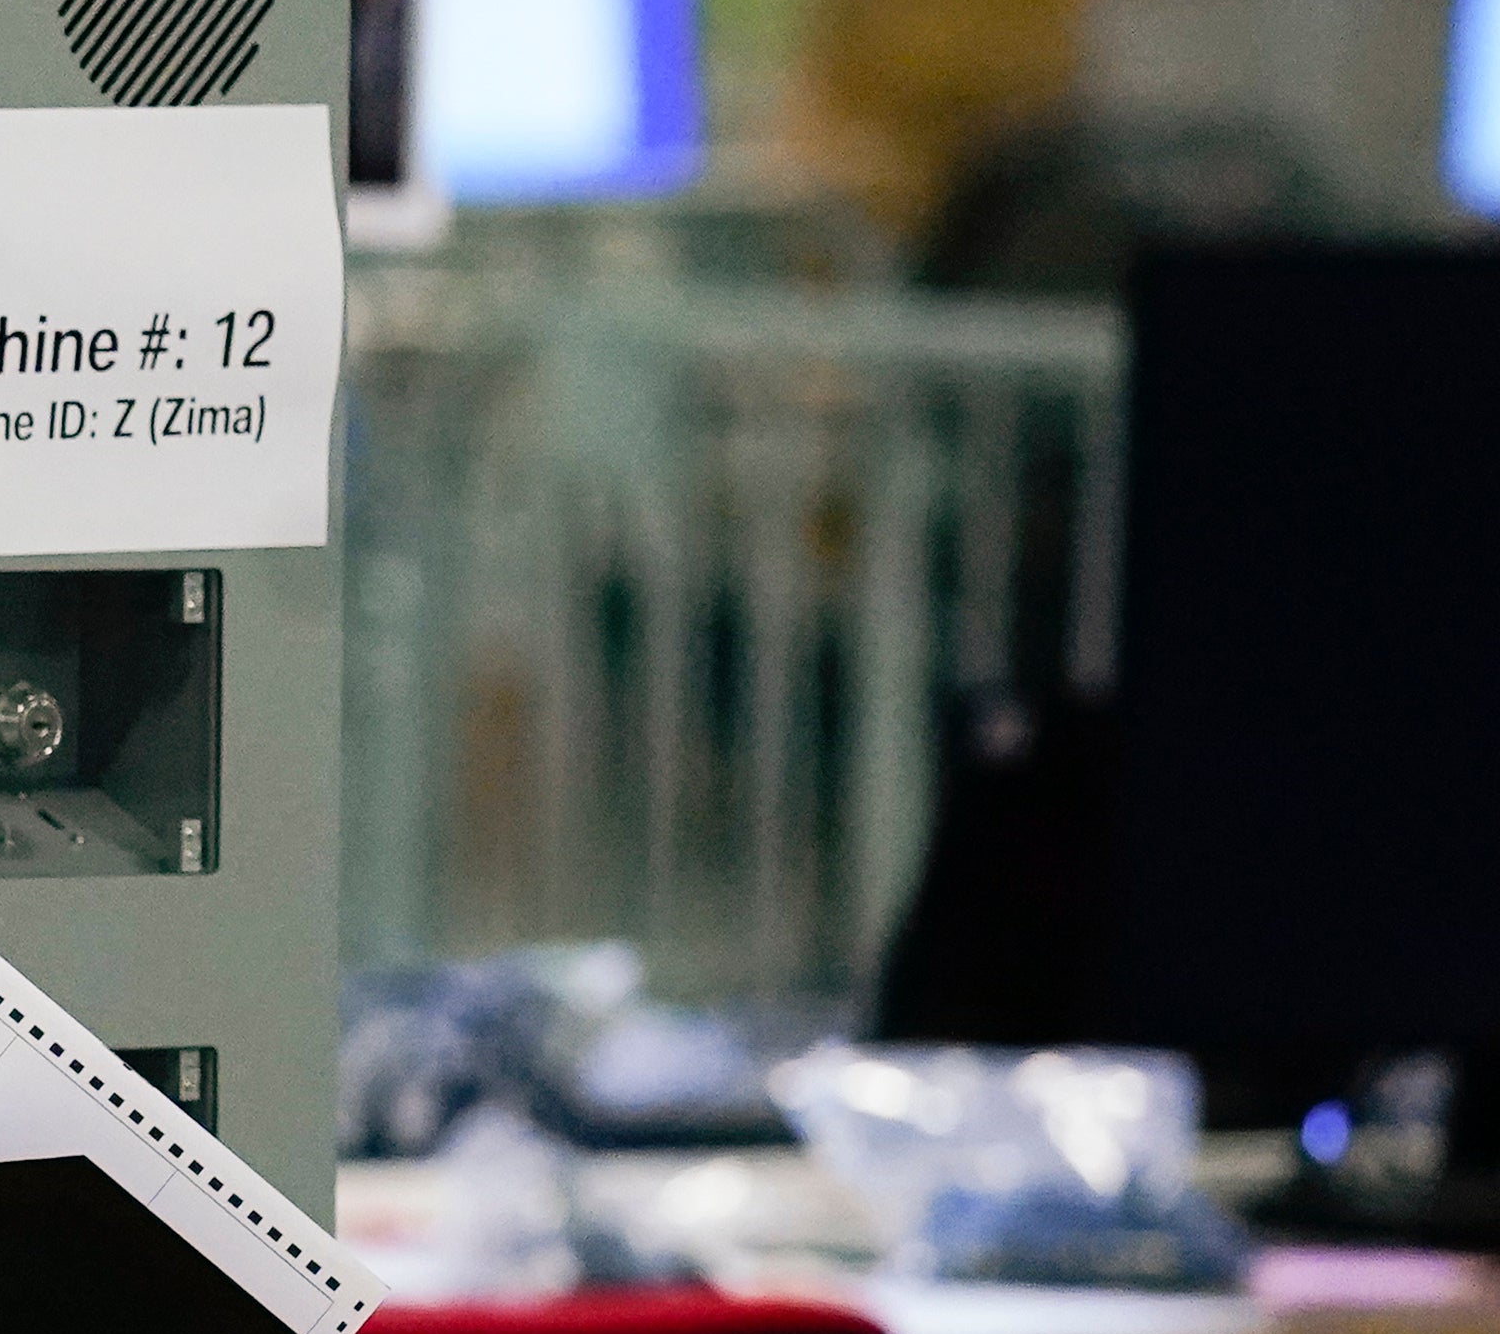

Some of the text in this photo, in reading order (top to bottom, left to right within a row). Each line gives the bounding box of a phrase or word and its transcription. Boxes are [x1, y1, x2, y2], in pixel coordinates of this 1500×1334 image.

[139, 312, 188, 370] #:
[215, 309, 276, 368] 12
[48, 401, 99, 440] ID:
[113, 398, 135, 438] Z
[150, 395, 266, 444] (Zima)
